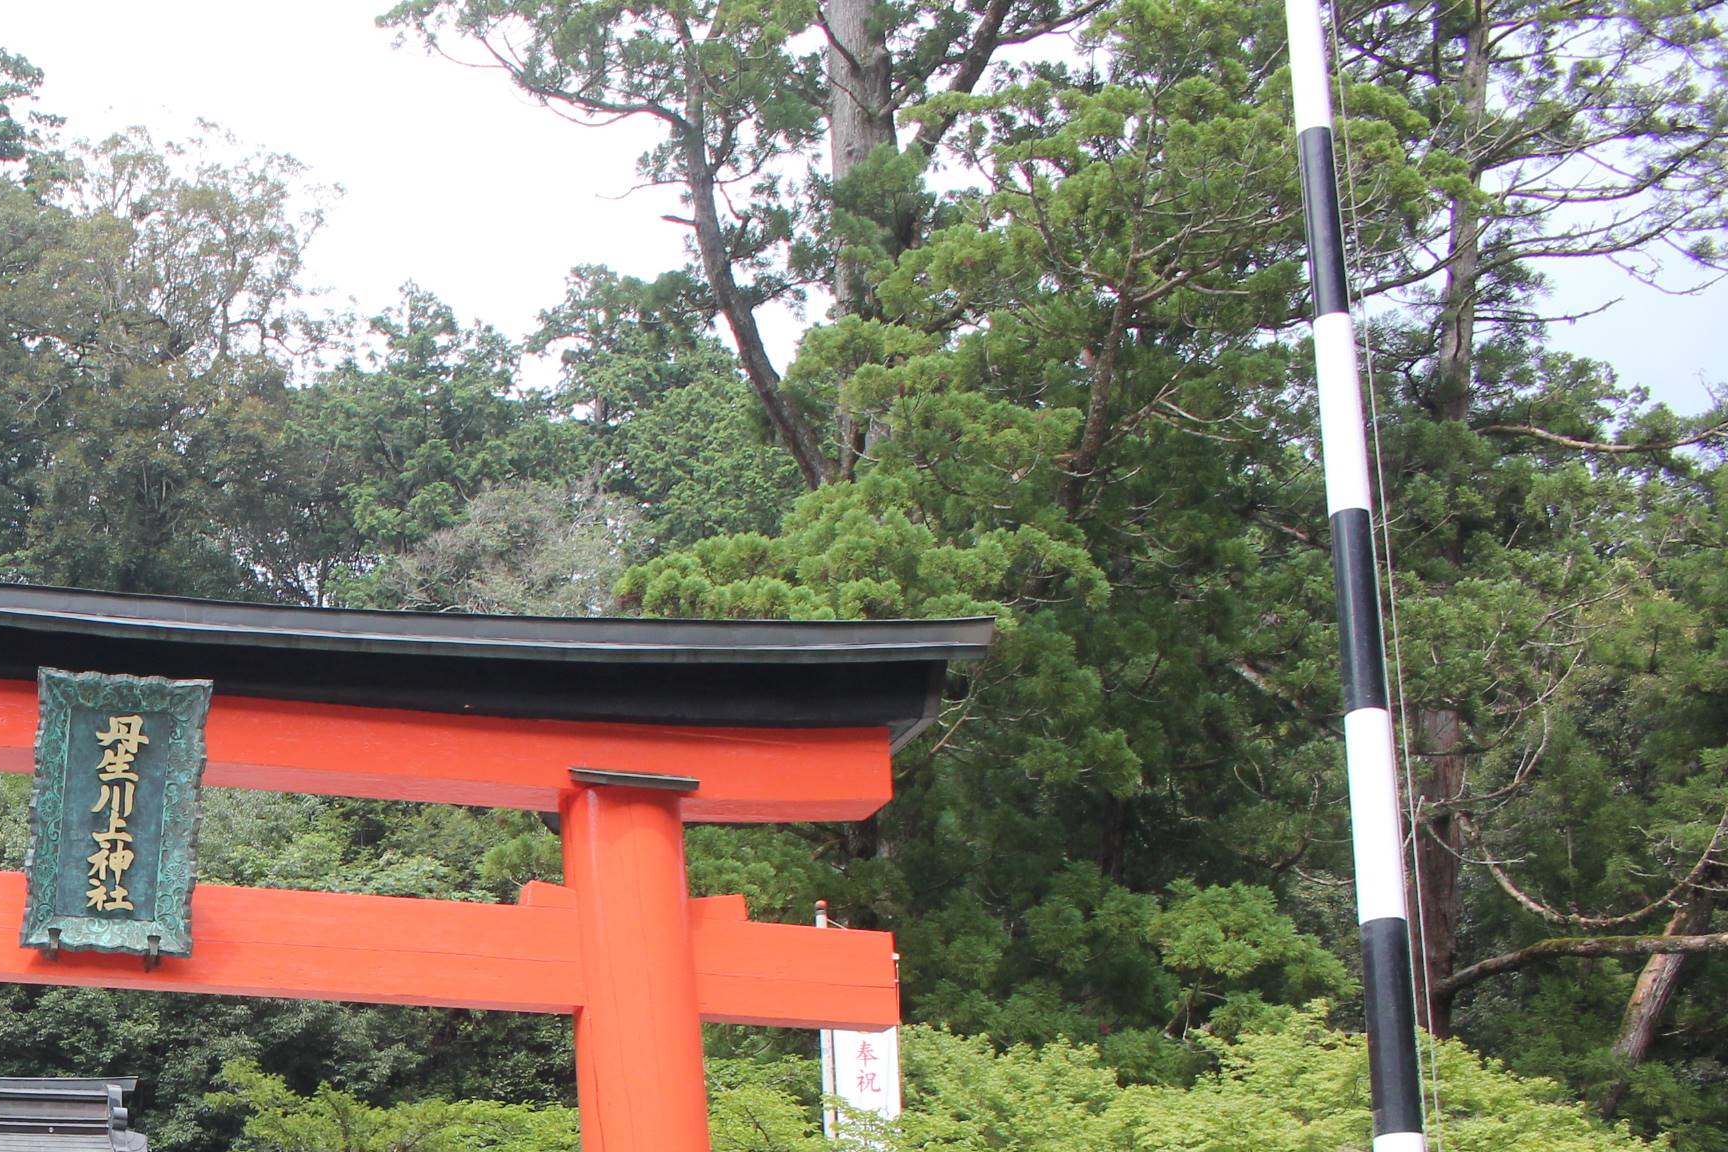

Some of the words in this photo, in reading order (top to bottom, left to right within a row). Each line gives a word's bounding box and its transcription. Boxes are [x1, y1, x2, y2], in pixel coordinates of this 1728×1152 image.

[85, 714, 149, 912] 丹生川上神社
[855, 1039, 881, 1093] 奉祝
